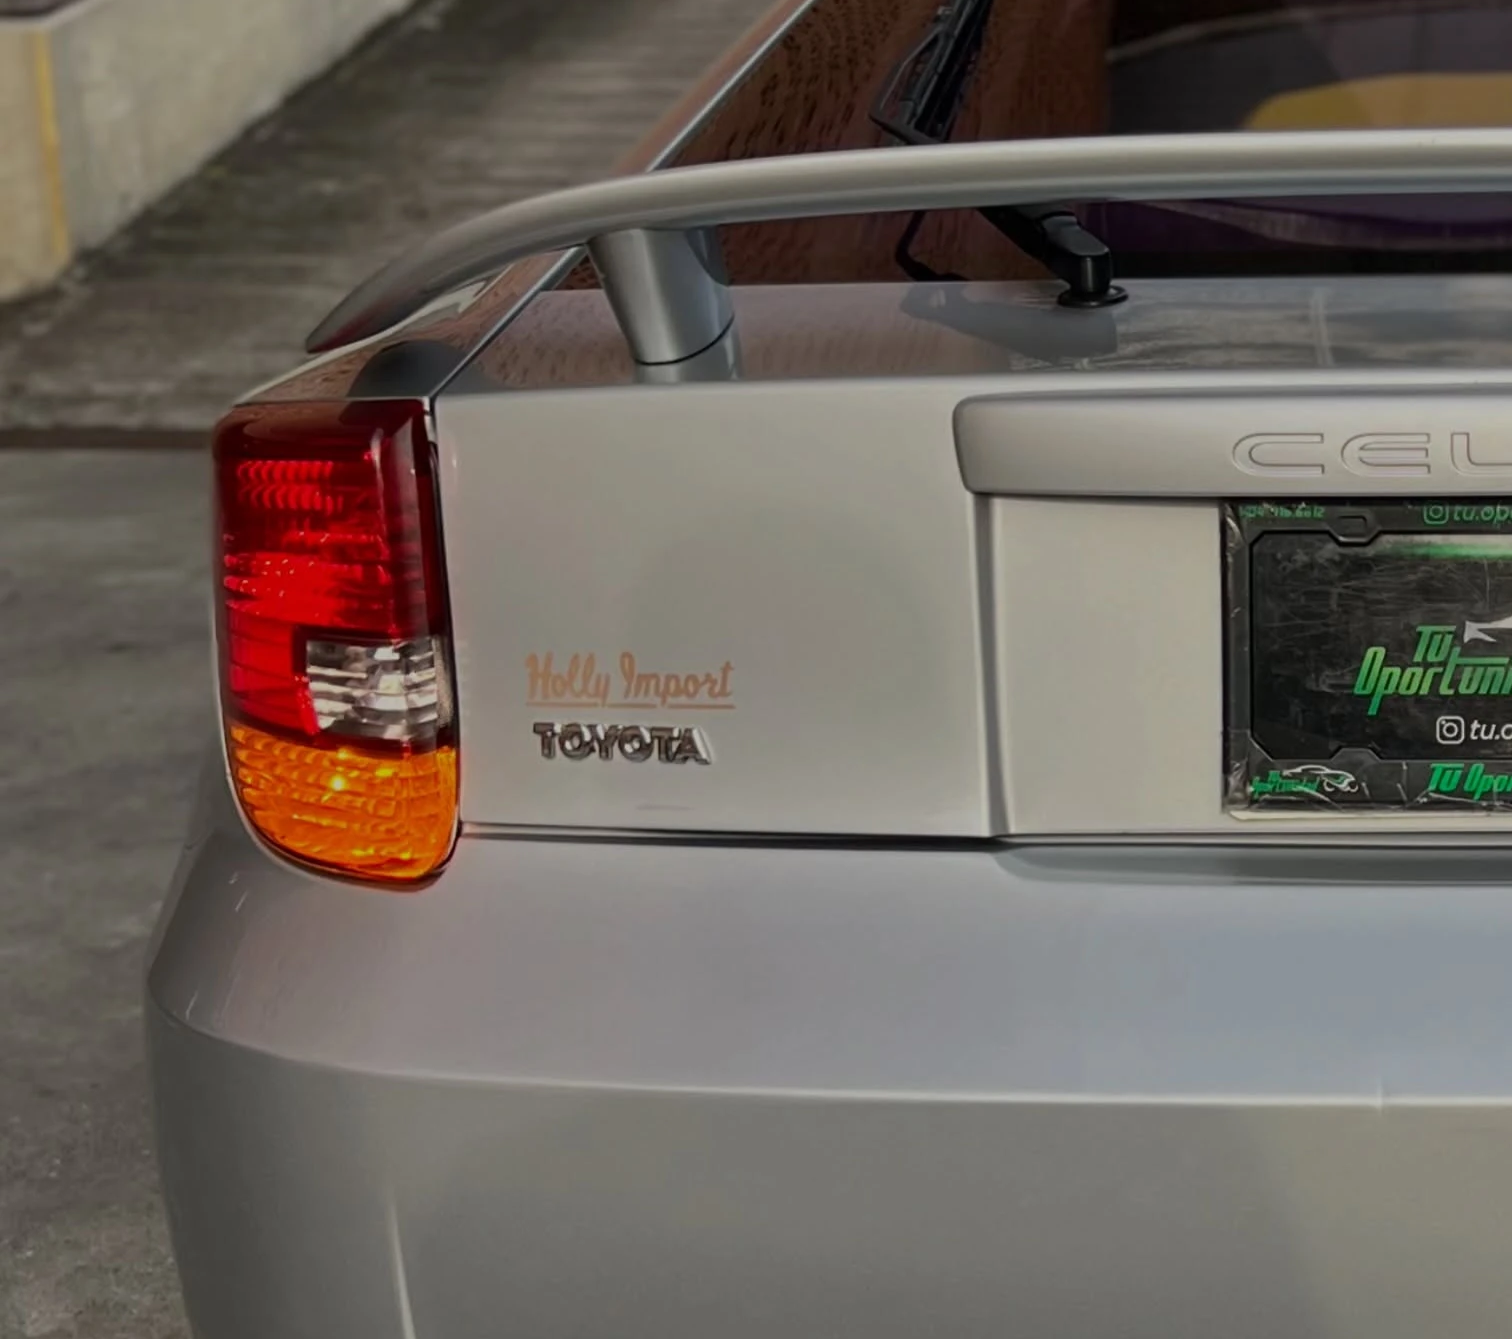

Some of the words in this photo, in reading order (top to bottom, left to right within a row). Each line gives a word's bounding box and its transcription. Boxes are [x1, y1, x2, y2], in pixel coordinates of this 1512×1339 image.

[524, 650, 611, 707] Holly
[619, 651, 736, 706] Import
[533, 721, 713, 765] TOYOTA
